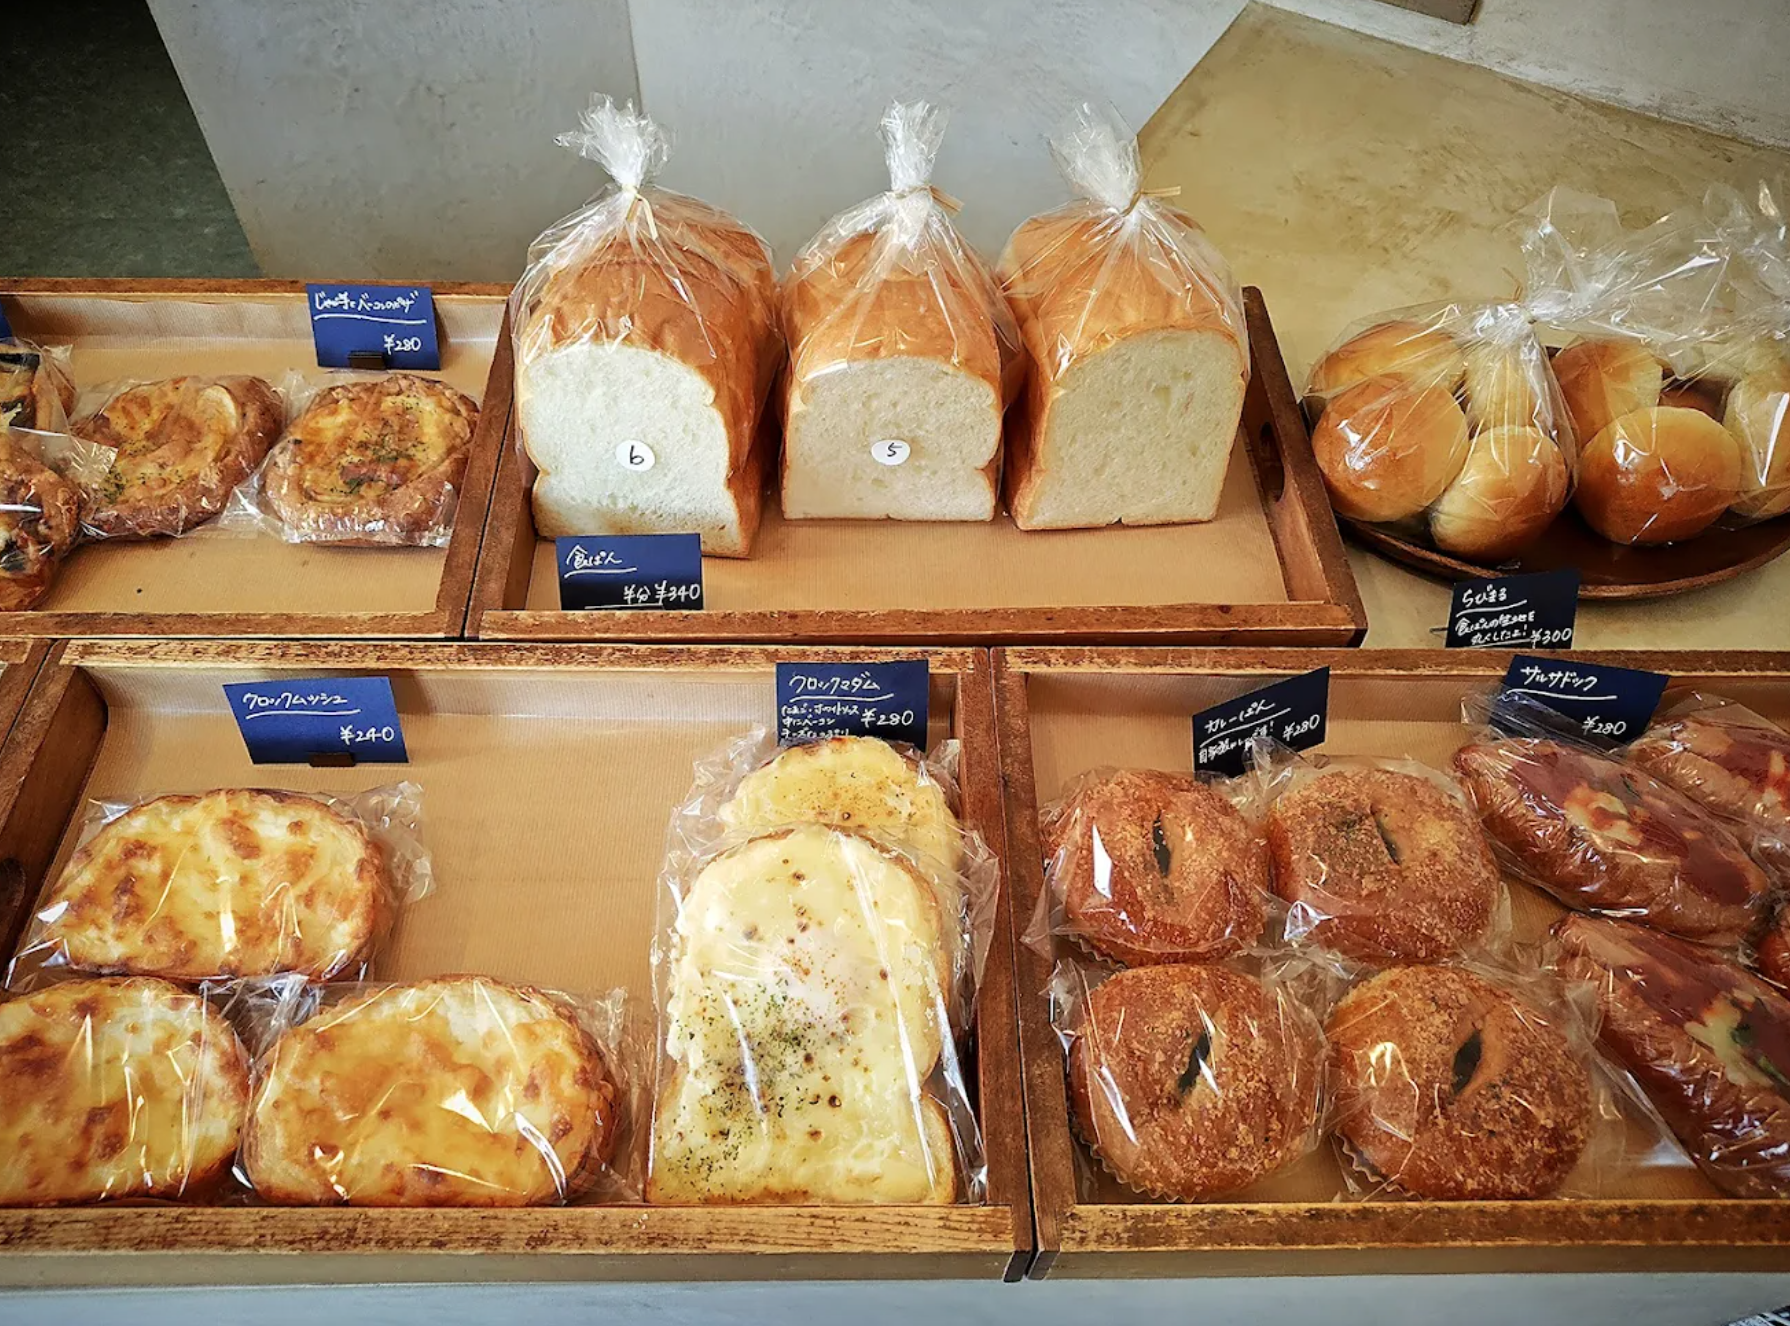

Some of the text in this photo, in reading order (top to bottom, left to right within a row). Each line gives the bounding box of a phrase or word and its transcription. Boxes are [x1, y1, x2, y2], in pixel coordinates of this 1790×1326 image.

[383, 334, 422, 355] ¥280
[886, 442, 903, 457] 5
[566, 544, 622, 569] 食ぱん
[654, 580, 701, 606] ¥340
[1462, 583, 1507, 608] ちびまる
[1529, 628, 1572, 650] ¥300
[788, 671, 881, 694] クロックマダム
[1519, 665, 1598, 691] サルサドック
[242, 692, 348, 710] クロックムッシュ
[860, 708, 914, 729] ¥280
[1204, 699, 1276, 734] カレーぱん
[1581, 715, 1627, 736] ¥280
[340, 724, 395, 745] ¥240
[1282, 714, 1320, 742] ¥280
